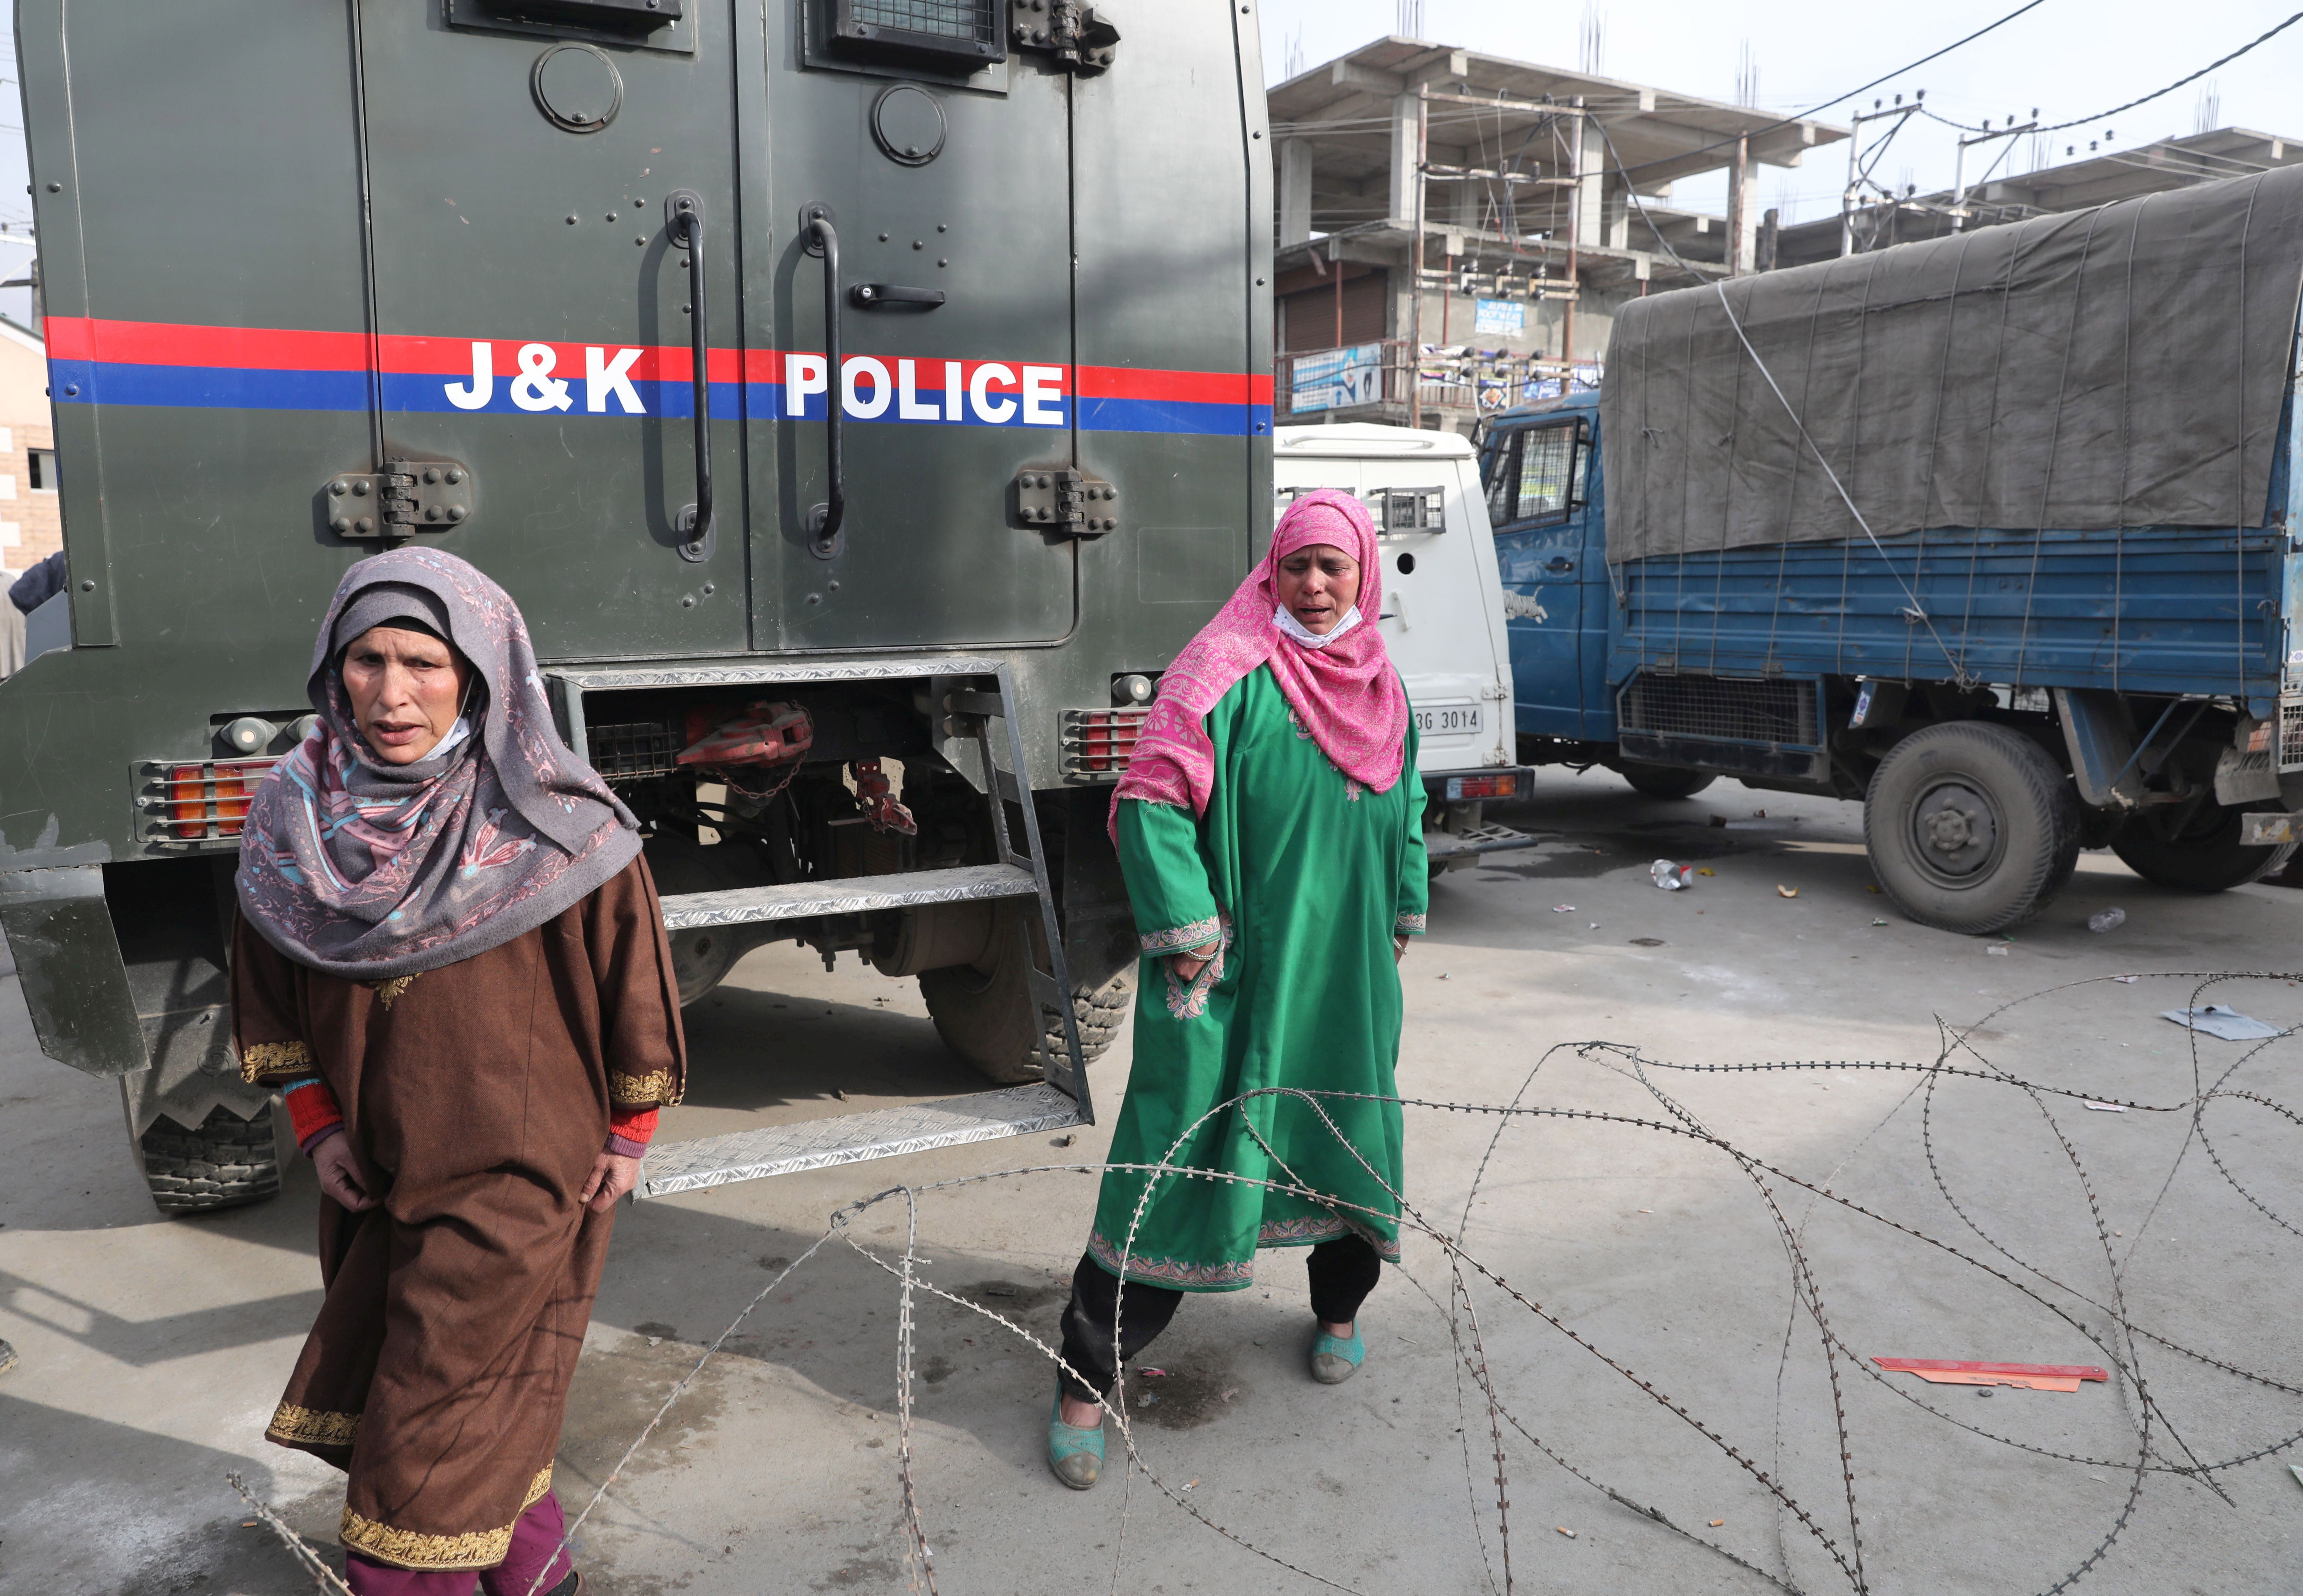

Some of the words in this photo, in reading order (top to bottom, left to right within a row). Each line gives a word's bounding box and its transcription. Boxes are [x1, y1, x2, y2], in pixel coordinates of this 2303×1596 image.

[444, 341, 647, 414] J&K
[785, 353, 1064, 425] POLICE
[1442, 710, 1476, 729] 3014
